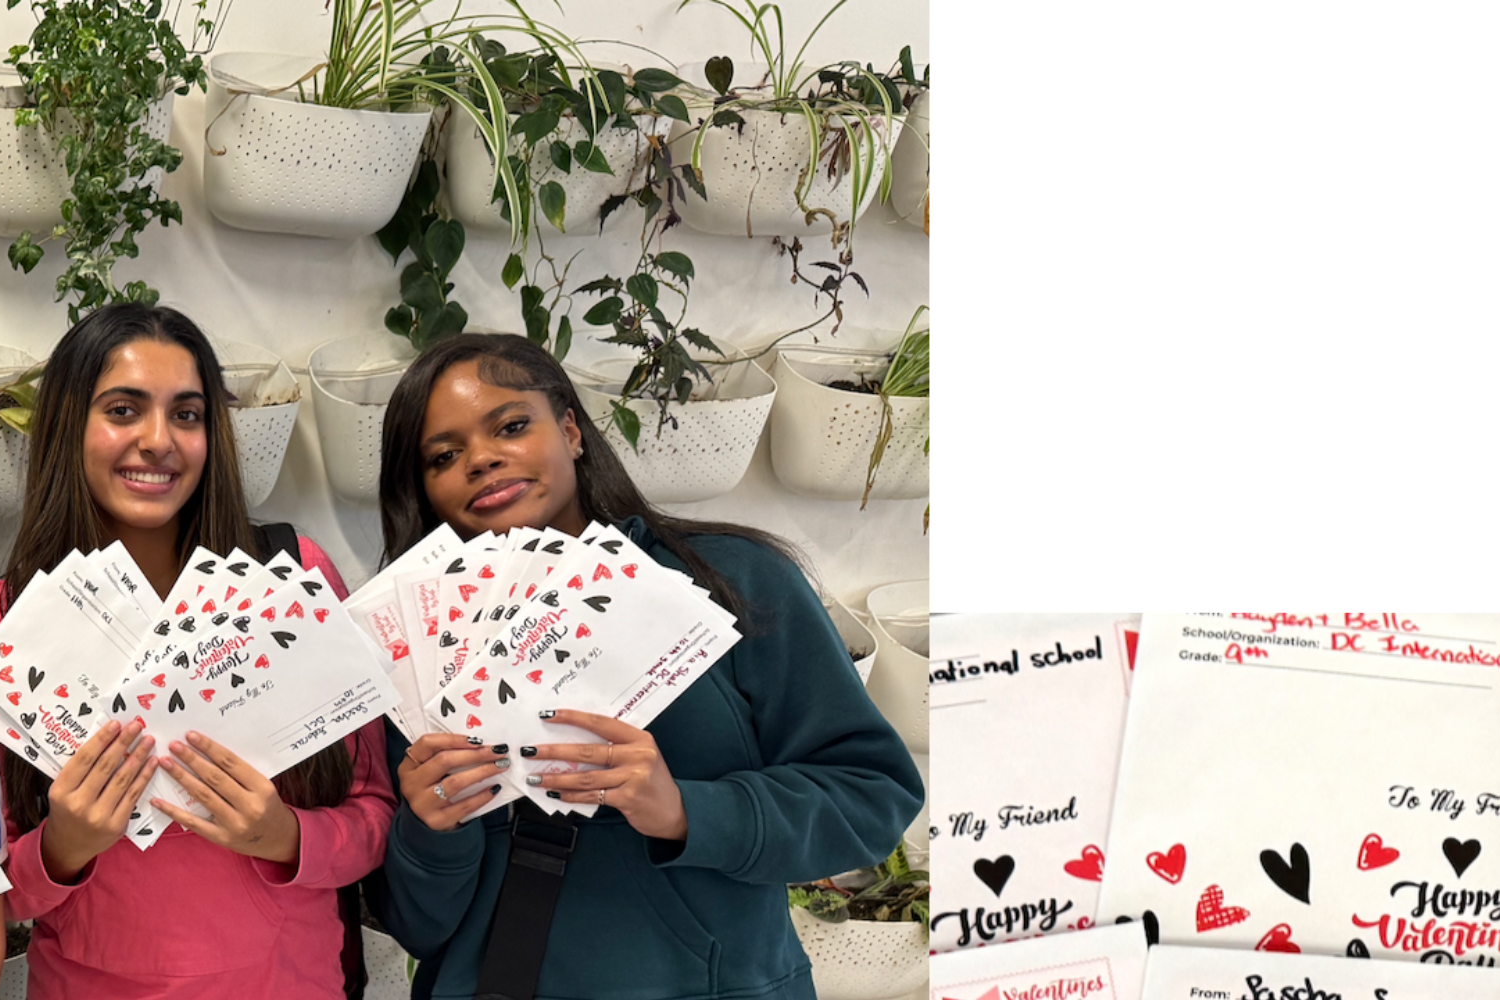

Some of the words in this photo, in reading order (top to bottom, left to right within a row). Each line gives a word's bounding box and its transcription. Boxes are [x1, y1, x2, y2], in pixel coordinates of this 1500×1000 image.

[193, 635, 225, 664] Day
[510, 616, 538, 650] Day
[529, 625, 569, 664] Happy
[1182, 627, 1321, 650] School/Organization:
[1331, 632, 1365, 651] DC
[206, 652, 250, 681] Happy
[1030, 635, 1102, 668] school
[1179, 650, 1223, 664] Grade:
[55, 704, 89, 739] Happy
[950, 812, 988, 842] My
[998, 796, 1079, 830] Friend
[1388, 785, 1421, 810] To
[1431, 788, 1466, 820] My
[930, 898, 1073, 947] Happy
[1190, 986, 1231, 1000] From:
